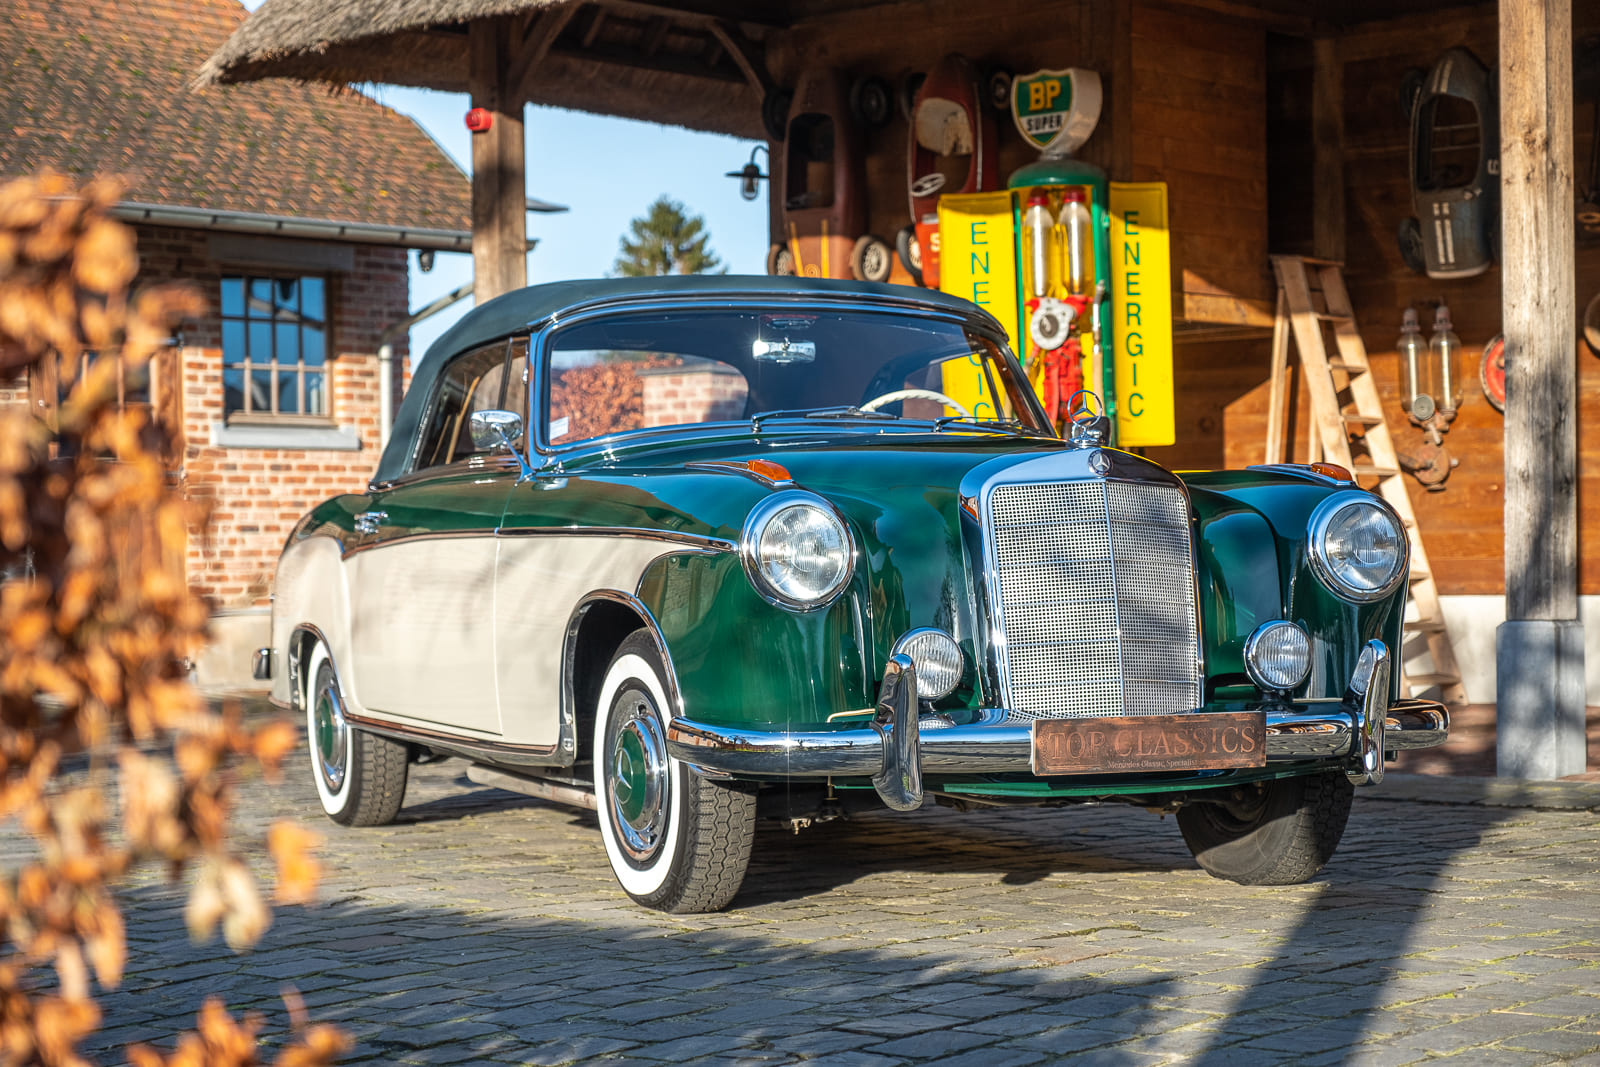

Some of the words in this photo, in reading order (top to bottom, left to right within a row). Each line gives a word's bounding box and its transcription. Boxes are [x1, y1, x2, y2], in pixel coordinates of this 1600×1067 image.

[1028, 79, 1061, 111] BP
[1027, 115, 1062, 131] SUPER
[969, 222, 992, 422] ENEIC
[1123, 211, 1144, 417] ENERGIC
[1050, 731, 1105, 759] TOP
[1115, 727, 1255, 757] CLASSICS
